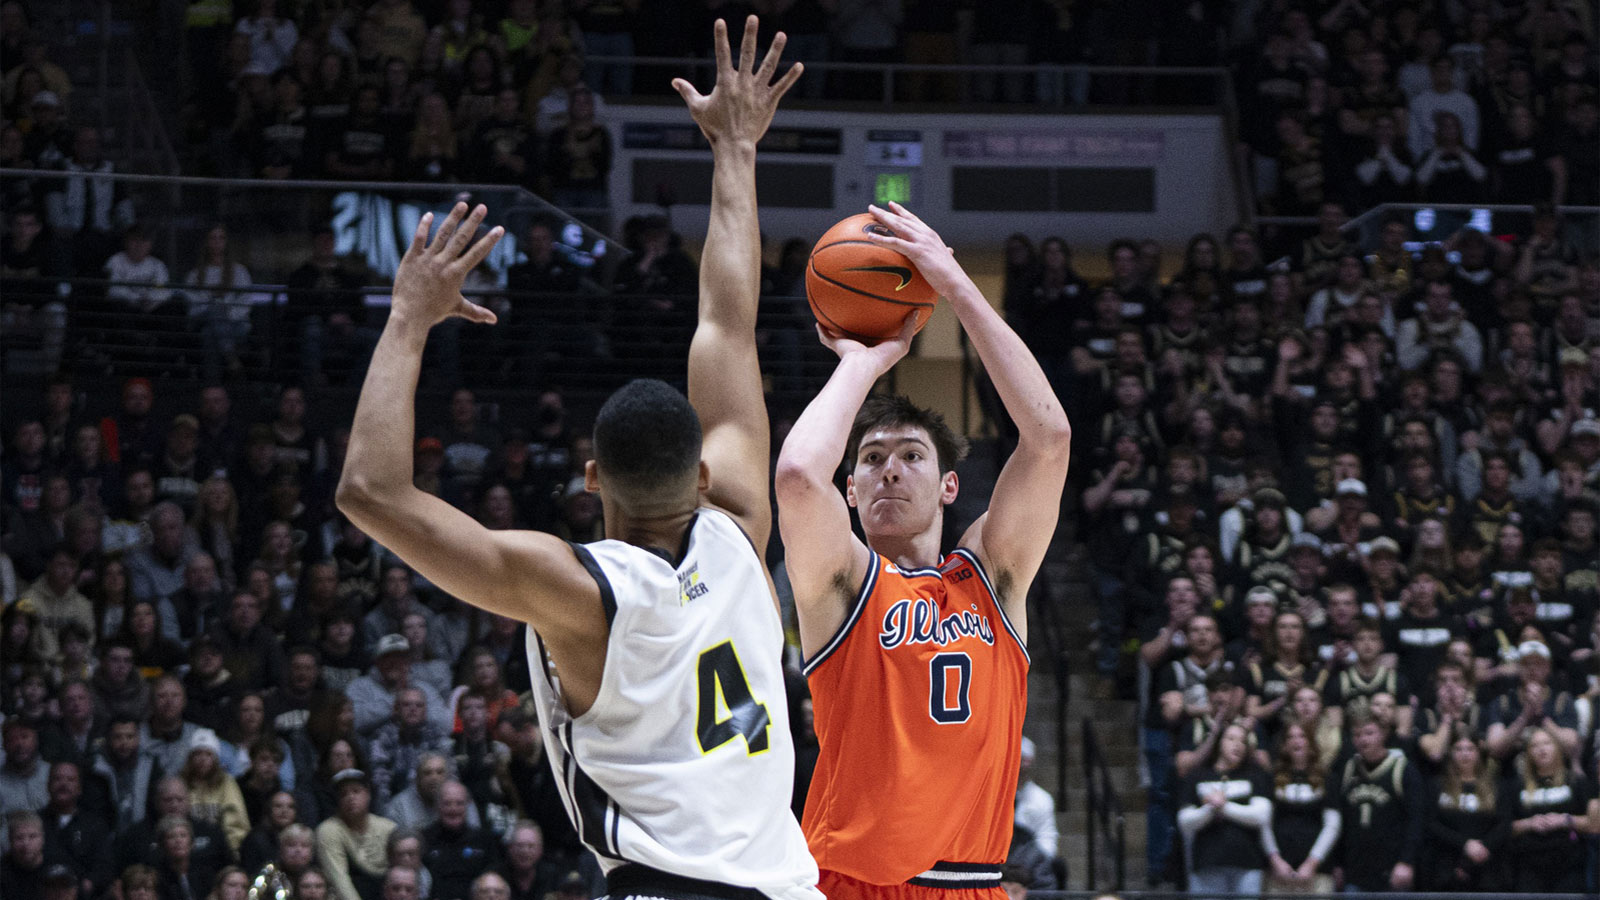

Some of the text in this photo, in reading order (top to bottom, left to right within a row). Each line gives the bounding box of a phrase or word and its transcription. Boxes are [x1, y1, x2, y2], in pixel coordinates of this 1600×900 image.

[880, 598, 994, 649] Illnois
[697, 638, 771, 756] 4
[929, 652, 972, 725] 0
